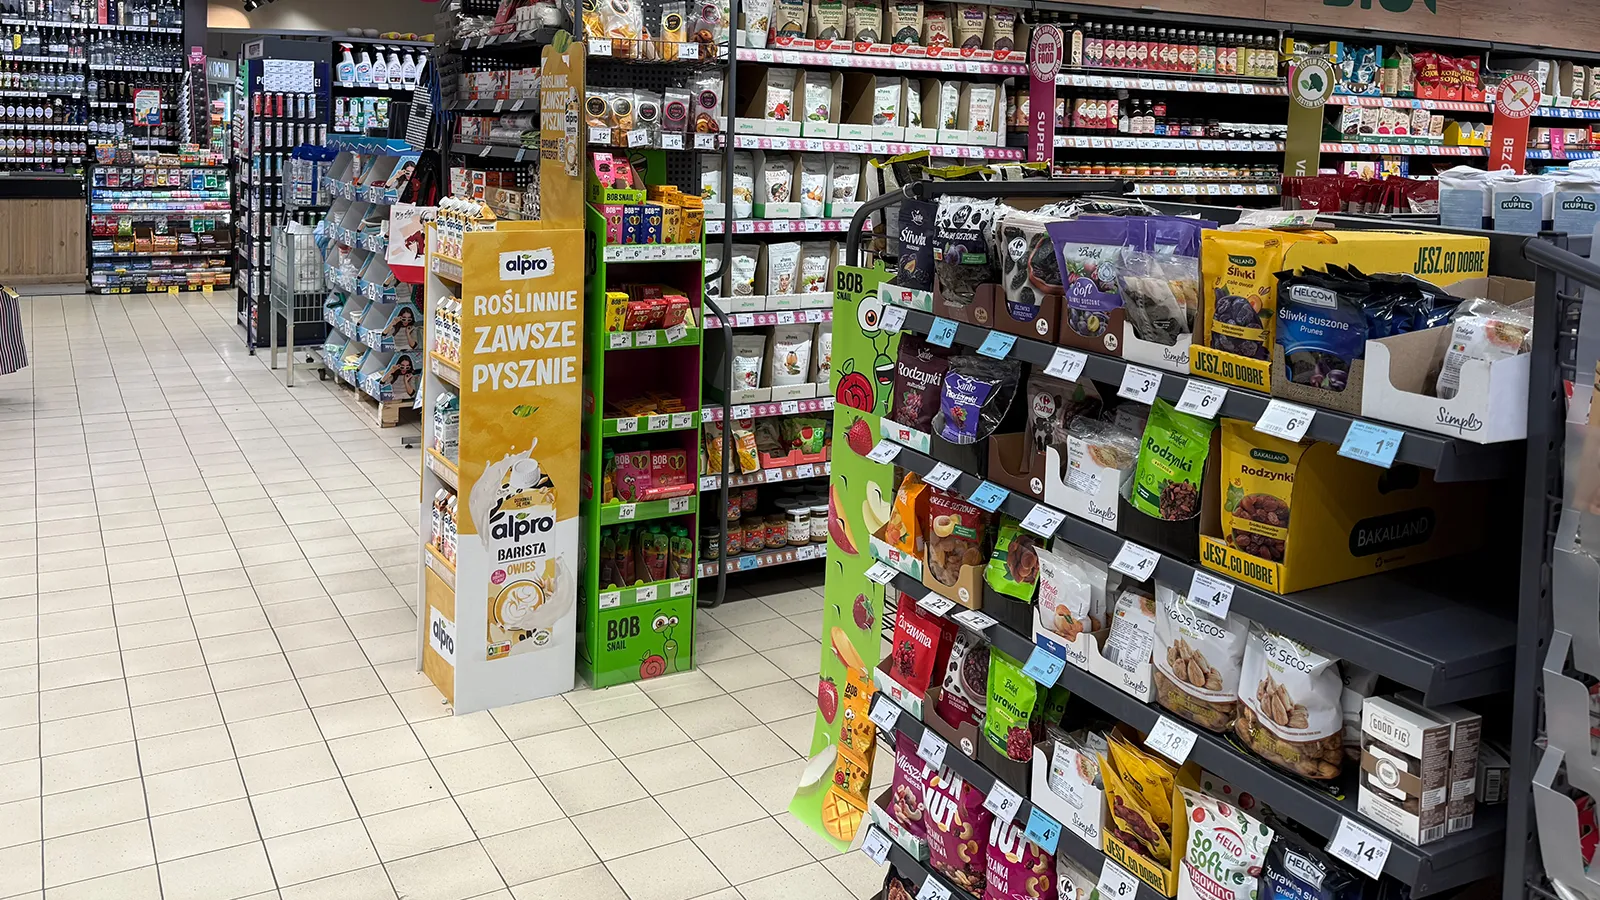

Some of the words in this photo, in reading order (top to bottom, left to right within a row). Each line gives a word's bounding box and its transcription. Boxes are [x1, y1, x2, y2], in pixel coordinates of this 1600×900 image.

[930, 24, 946, 33] Goji
[998, 21, 1013, 29] Chia
[1038, 43, 1054, 52] SUPER
[1038, 52, 1054, 64] FOOD
[541, 112, 565, 131] PYSZNI
[1036, 111, 1045, 161] SUPER
[1502, 202, 1531, 210] KUPIEC
[1564, 202, 1596, 211] KUPIEC
[505, 254, 547, 275] alpro
[1443, 251, 1456, 274] CO
[1457, 250, 1485, 273] DOBRE
[837, 270, 863, 294] BOB
[1227, 265, 1256, 280] Śliwki
[836, 291, 853, 302] SNAIL
[1073, 281, 1093, 298] Soft
[1293, 286, 1333, 303] HELCOM
[473, 288, 577, 316] ROŚLINNIE
[1279, 307, 1307, 323] Śliwki
[1308, 316, 1349, 331] suszone
[473, 320, 577, 355] ZAWSZE
[1300, 325, 1324, 336] Prunes
[472, 356, 577, 393] PYSZNIE
[897, 361, 942, 387] Rodzynki
[1222, 361, 1234, 378] CO
[1235, 364, 1265, 387] DOBRE
[1140, 379, 1150, 393] 3
[1201, 394, 1211, 408] 6
[1286, 418, 1297, 431] 6
[1145, 436, 1193, 473] Rodzynki
[1253, 450, 1287, 462] BAKALLAND
[1375, 439, 1384, 454] 1
[615, 455, 631, 465] BOB
[652, 454, 668, 465] BOB
[1241, 464, 1294, 483] Rodzynki
[491, 514, 554, 543] alpro
[1042, 518, 1053, 529] 2
[1357, 517, 1428, 547] BAKALLAND
[498, 542, 547, 562] BARISTA
[507, 560, 536, 577] OWIES
[1137, 558, 1148, 570] 4
[1230, 554, 1243, 572] CO
[1243, 559, 1273, 586] DOBRE
[1212, 591, 1222, 606] 4
[433, 618, 455, 656] alpro
[607, 615, 640, 642] BOB
[898, 612, 932, 649] Żurawina
[1193, 619, 1226, 640] SECOS
[606, 640, 627, 653] SNAIL
[1278, 649, 1313, 674] SECOS
[845, 682, 858, 698] BOB
[992, 691, 1028, 719] urawina
[1372, 718, 1392, 735] GOOD
[1394, 728, 1407, 743] FIG
[1215, 832, 1243, 857] HELIO
[1357, 840, 1376, 862] 14
[1128, 857, 1138, 872] CO
[1137, 861, 1164, 892] DOBRE
[1117, 881, 1126, 897] 8
